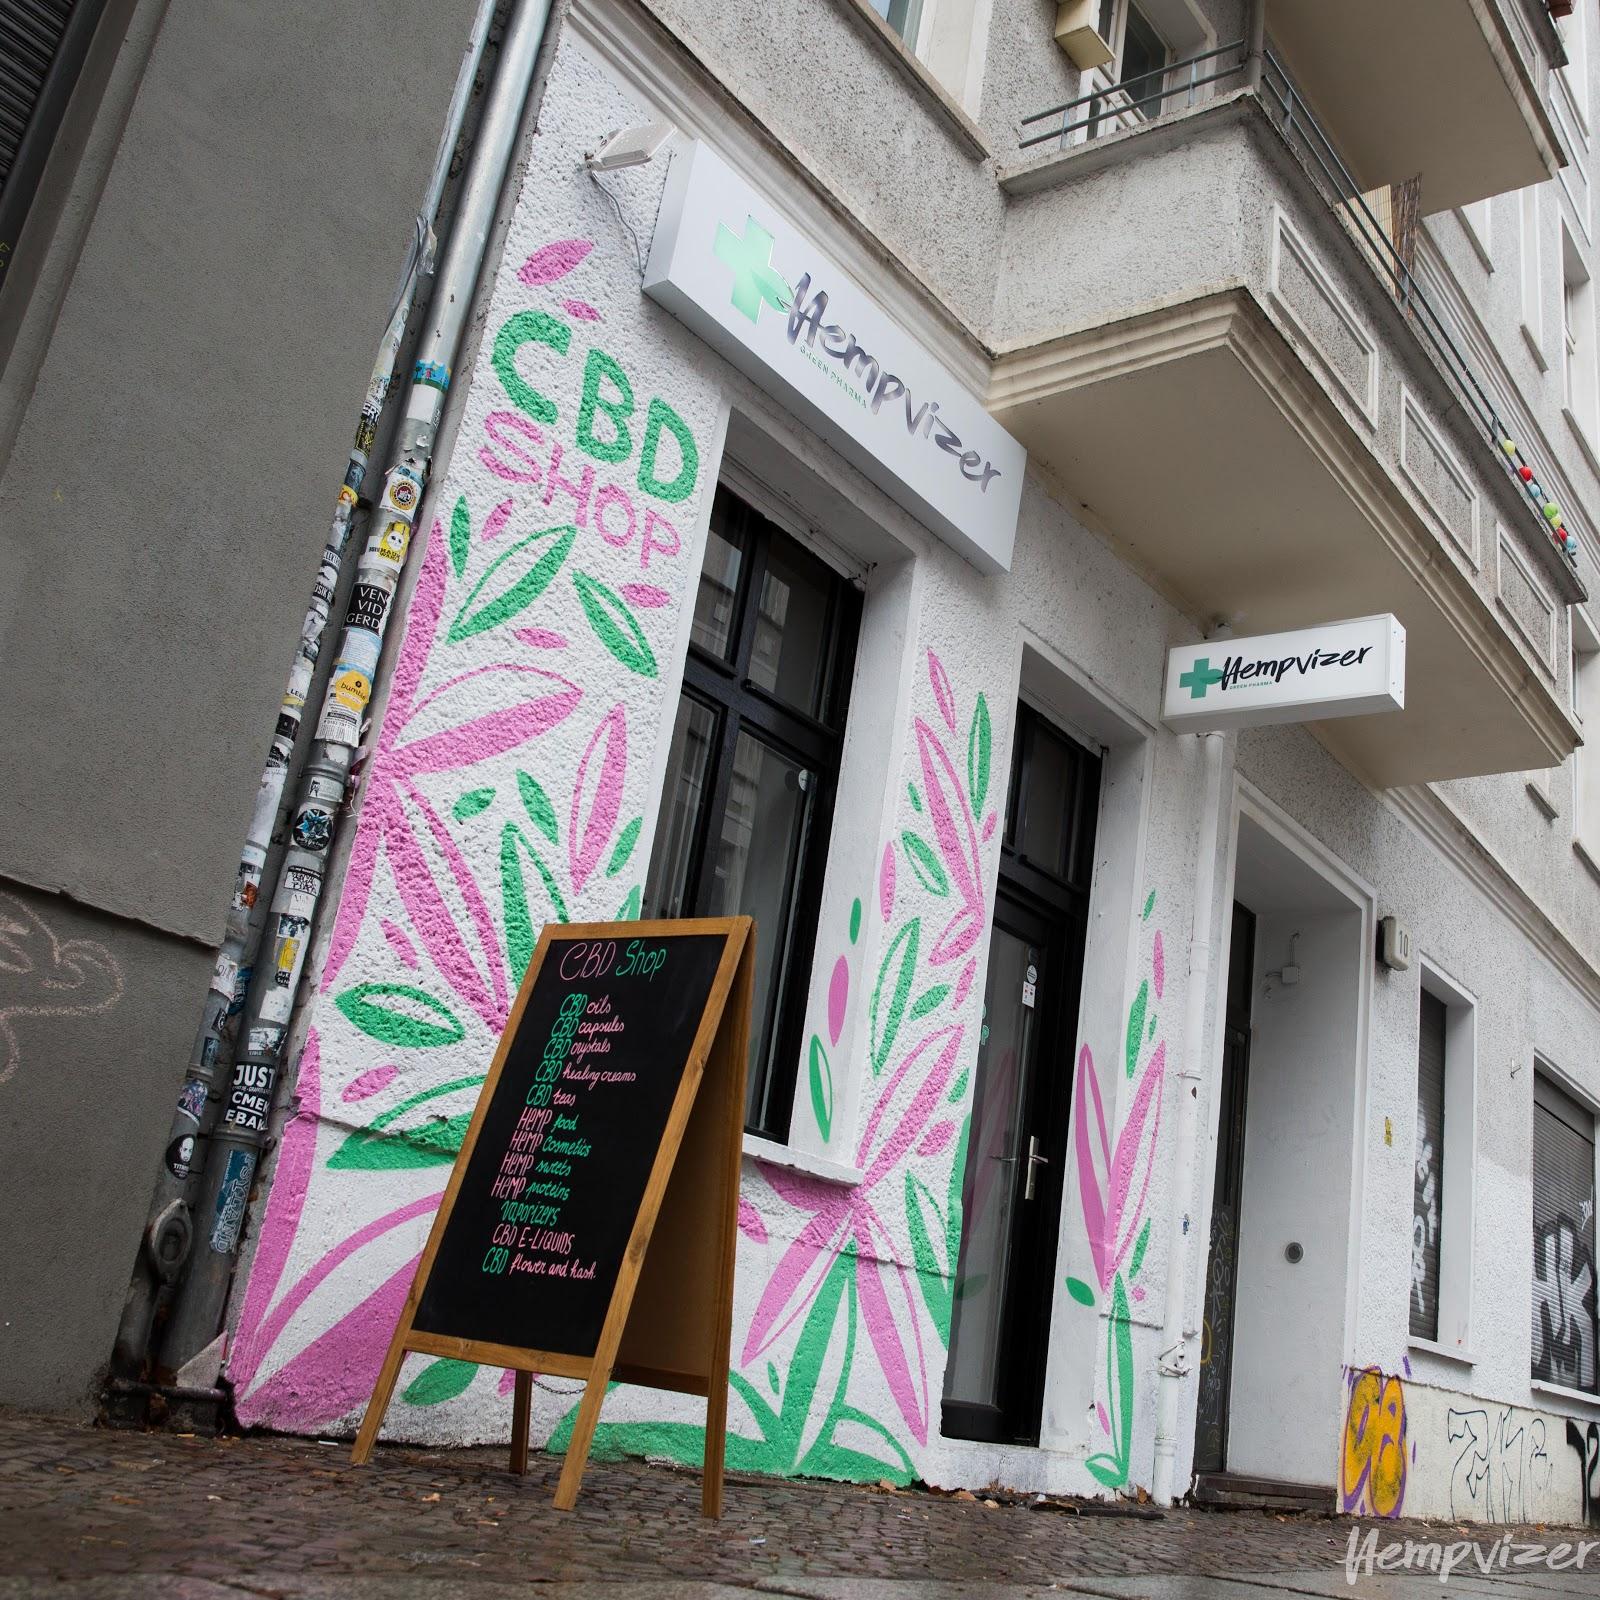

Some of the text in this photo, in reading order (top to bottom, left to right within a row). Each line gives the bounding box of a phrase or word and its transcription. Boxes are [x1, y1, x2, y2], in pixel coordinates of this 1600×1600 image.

[786, 272, 1001, 494] Hempvizer
[800, 345, 867, 408] GREEN PHARMA
[491, 310, 699, 503] CBD
[479, 411, 681, 569] SHOP
[346, 612, 381, 629] GERD
[1217, 646, 1373, 691] Hempvizer
[1399, 930, 1409, 958] 10
[560, 940, 667, 982] CBD Shop
[560, 993, 611, 1017] CBD oils
[551, 1015, 625, 1041] CBD capsules
[543, 1037, 611, 1064] CBD crystals
[233, 1064, 275, 1088] JUST
[535, 1060, 637, 1090] CBD healing creams
[526, 1084, 576, 1107] CBD teas
[550, 1113, 580, 1133] food
[535, 1159, 572, 1176] sweets
[525, 1180, 571, 1201] proteins
[492, 1223, 518, 1246] CBD
[482, 1246, 509, 1275] CBD
[509, 1253, 547, 1276] flower
[548, 1260, 570, 1277] and
